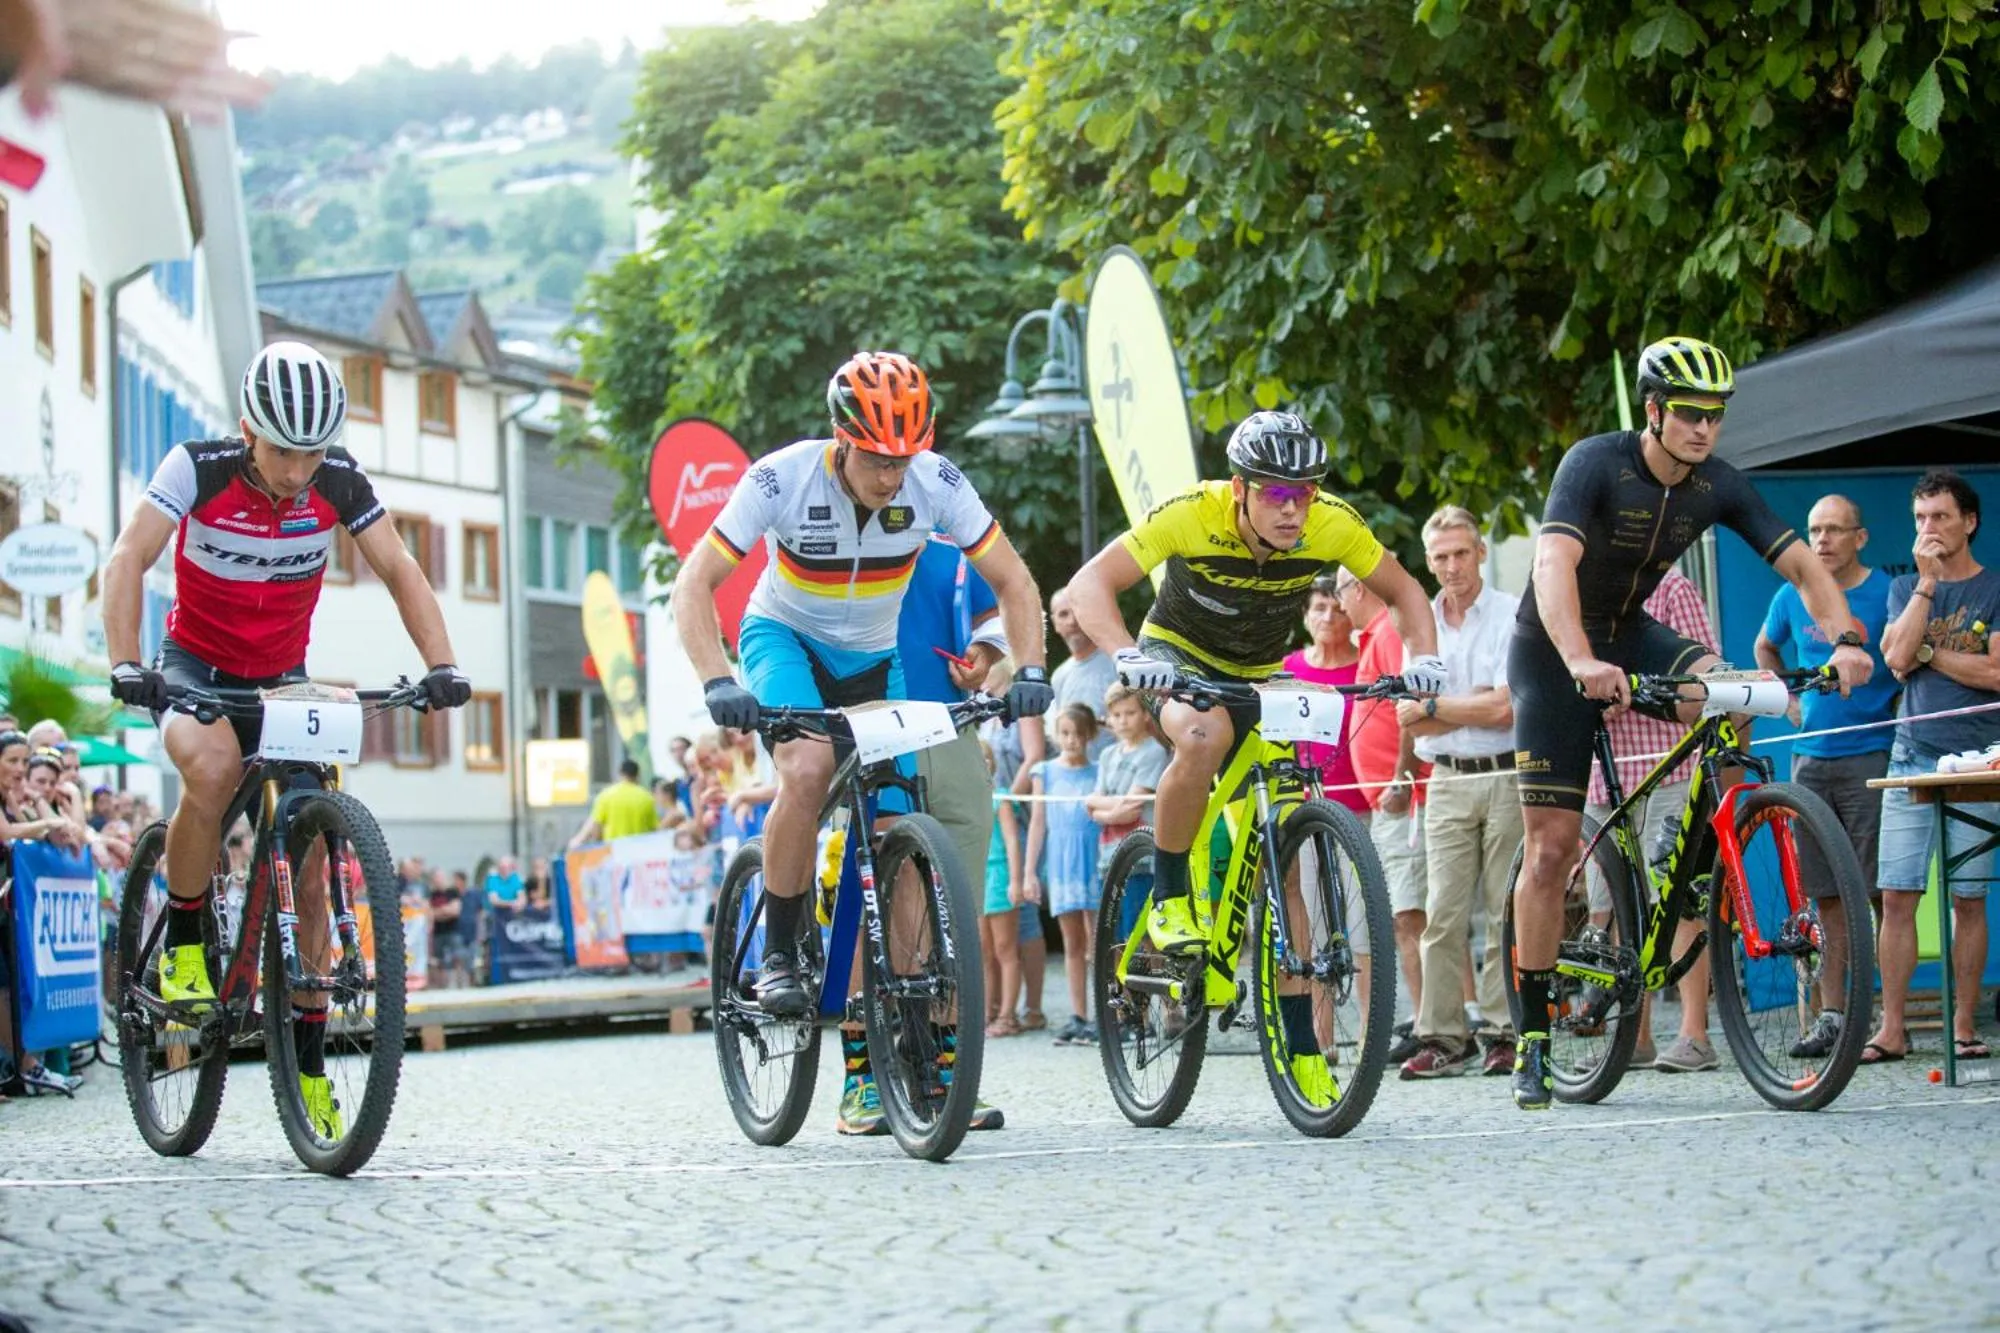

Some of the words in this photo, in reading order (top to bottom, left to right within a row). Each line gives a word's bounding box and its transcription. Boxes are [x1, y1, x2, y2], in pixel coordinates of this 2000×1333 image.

[196, 543, 327, 566] STEVENS
[1298, 695, 1310, 718] 3
[1741, 685, 1752, 706] 7
[307, 709, 320, 736] 5
[891, 709, 905, 729] 1
